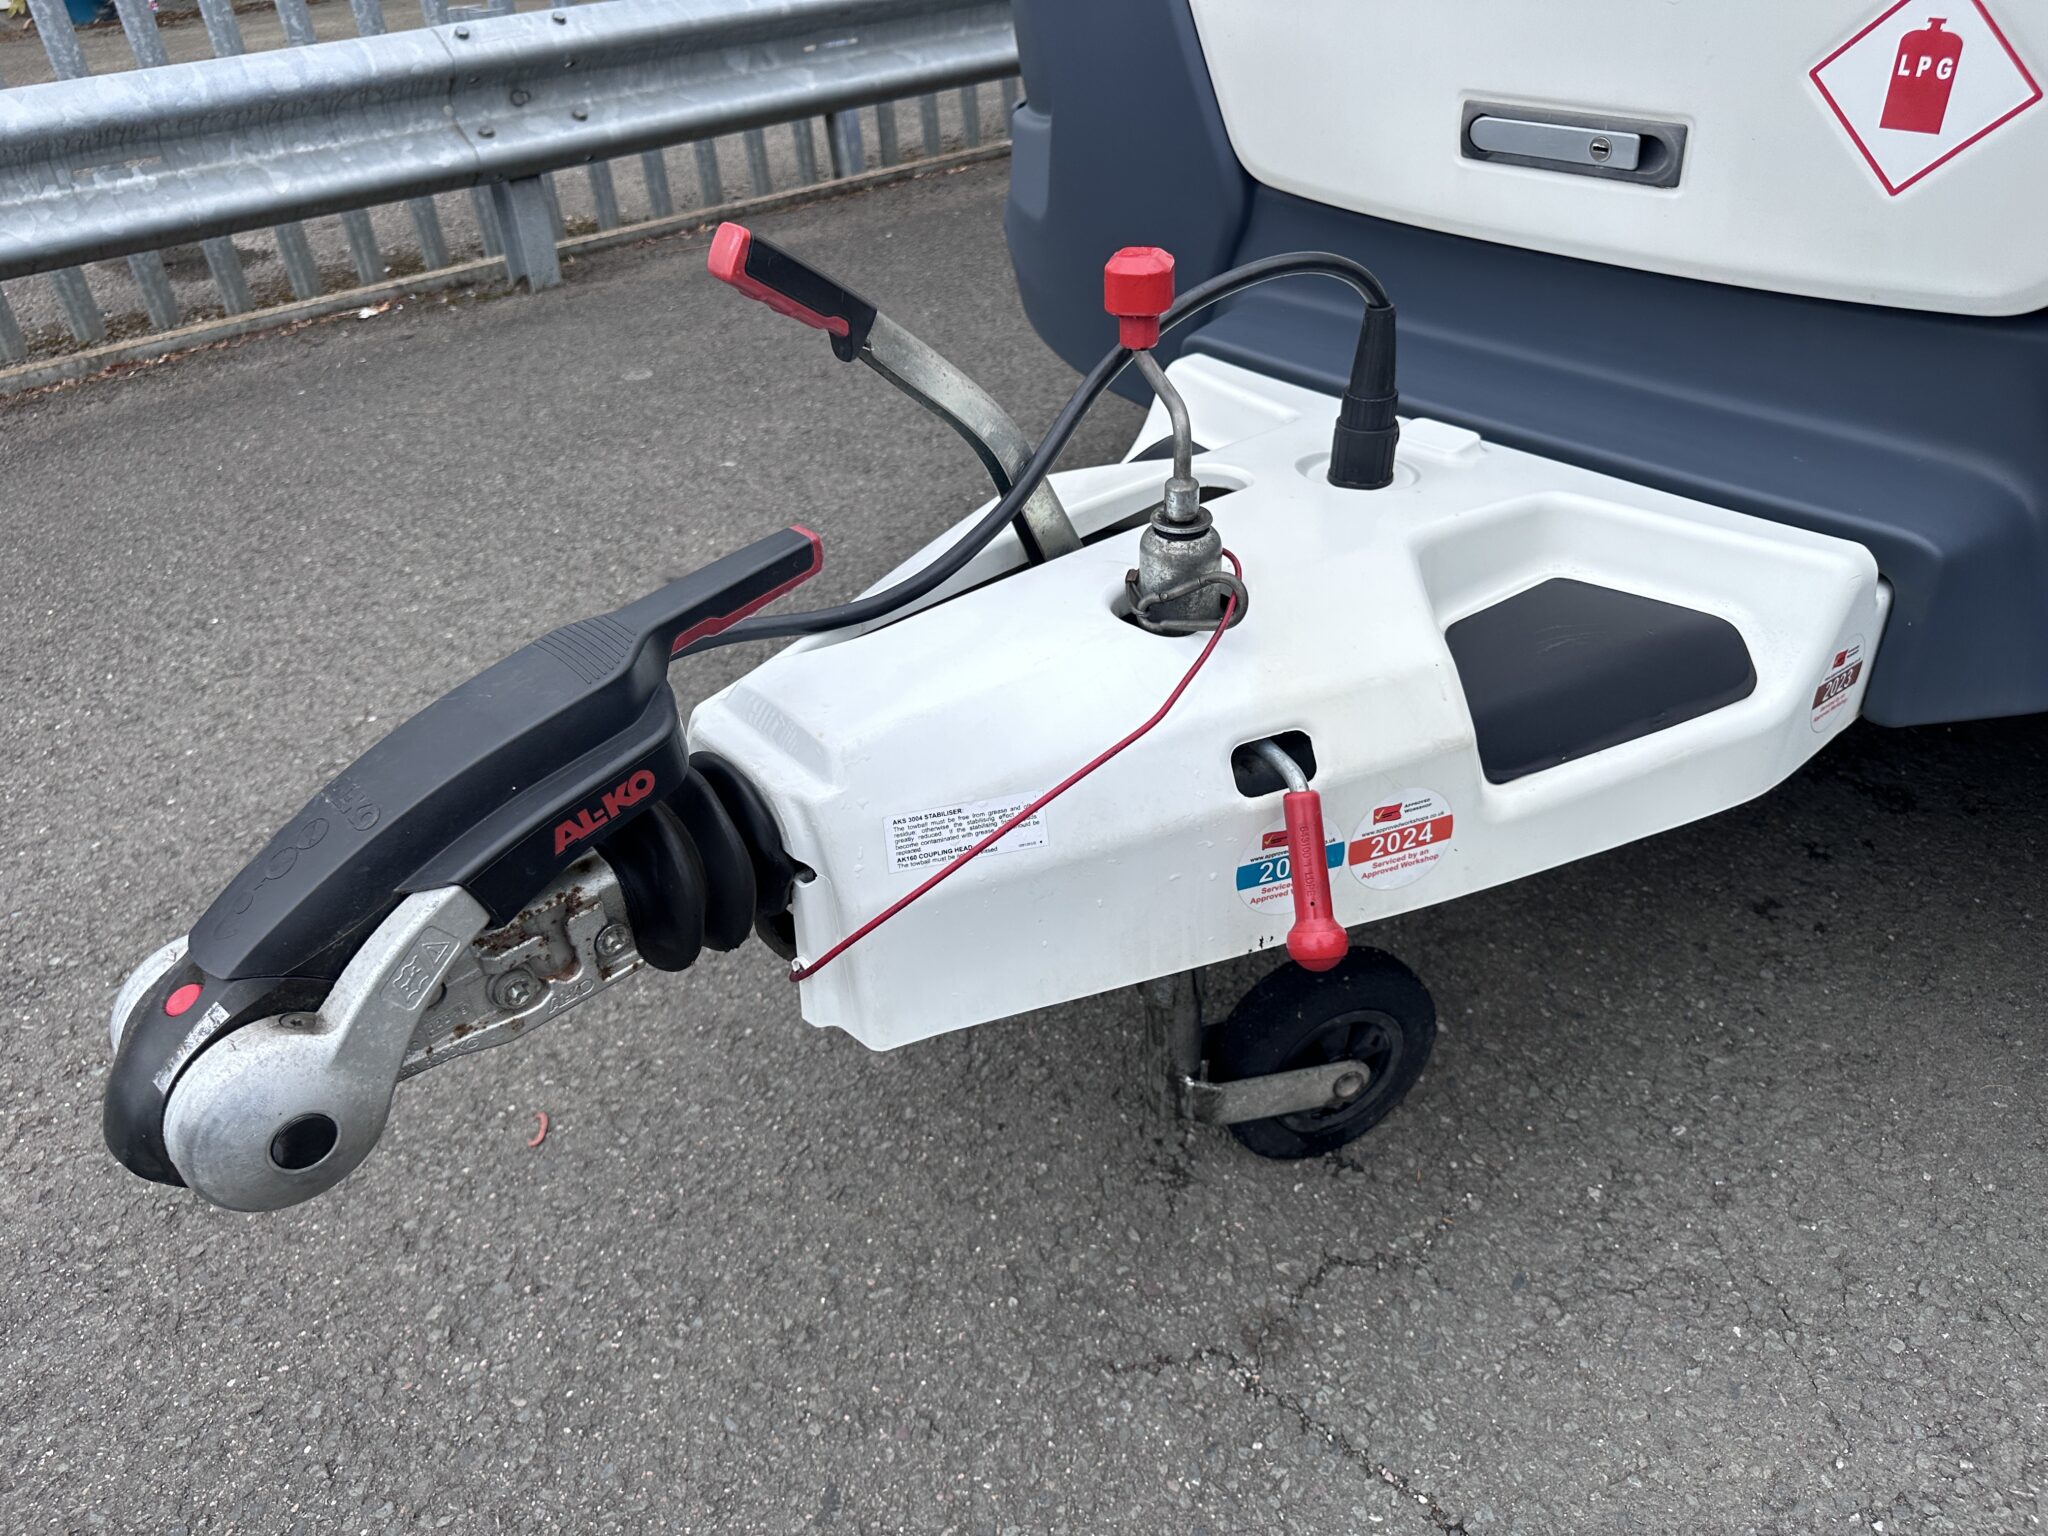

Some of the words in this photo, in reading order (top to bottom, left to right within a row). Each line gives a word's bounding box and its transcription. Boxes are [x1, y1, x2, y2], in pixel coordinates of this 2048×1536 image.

[1897, 53, 1953, 80] LPG
[1822, 668, 1853, 702] 2023
[554, 769, 656, 857] AL-KO
[892, 818, 906, 826] AKS
[908, 815, 923, 823] 3004
[1370, 822, 1433, 859] 2024
[1361, 864, 1399, 880] Approved
[1400, 853, 1440, 868] Workshop
[1372, 853, 1406, 869] Serviced
[1408, 851, 1418, 860] by
[1250, 890, 1289, 904] Approved
[1261, 883, 1293, 894] Service
